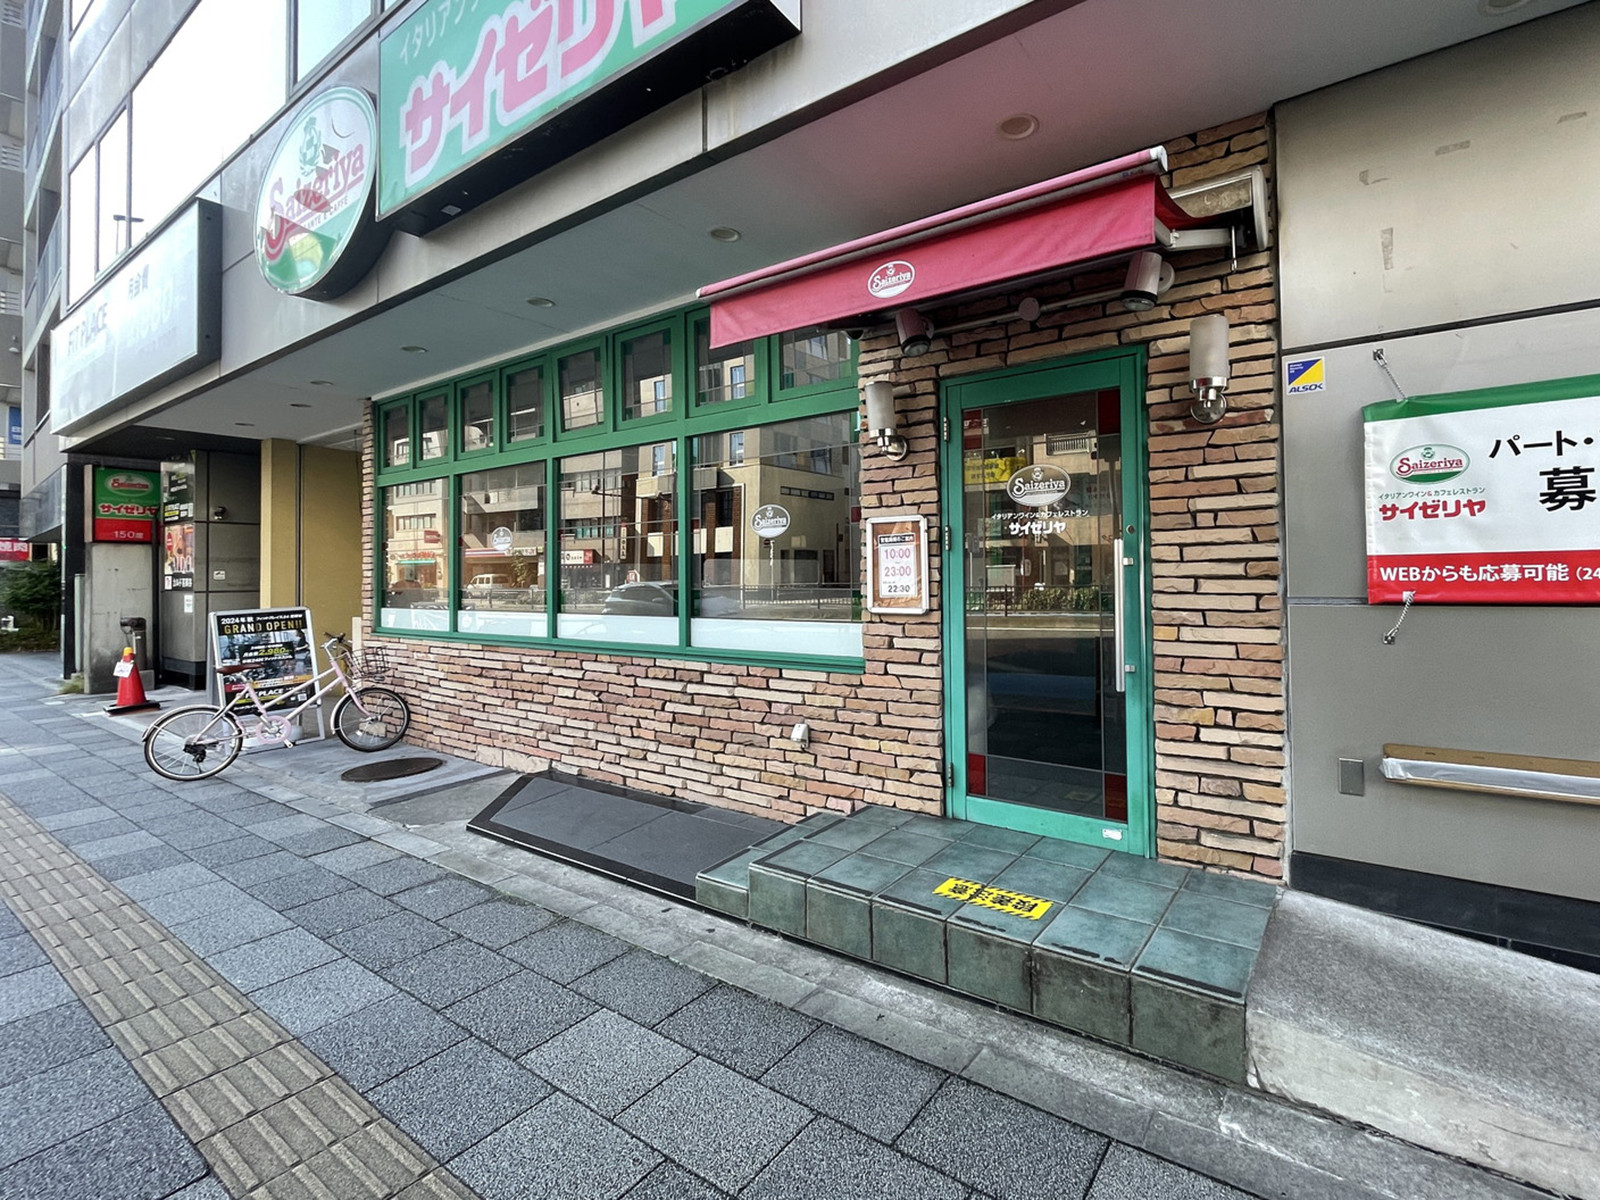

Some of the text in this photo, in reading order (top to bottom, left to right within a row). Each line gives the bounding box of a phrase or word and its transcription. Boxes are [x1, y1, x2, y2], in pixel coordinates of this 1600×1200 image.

[1288, 382, 1324, 394] ALSOK
[1396, 457, 1463, 474] Saizeriya
[1012, 477, 1066, 496] Saizeriya
[1539, 465, 1597, 512] 募
[1379, 498, 1487, 522] サイゼリヤ
[1008, 520, 1067, 536] サイゼリヤ
[884, 548, 911, 560] 10:00
[884, 565, 912, 578] 23:00
[887, 584, 911, 593] 22:30
[223, 623, 262, 635] GRAND
